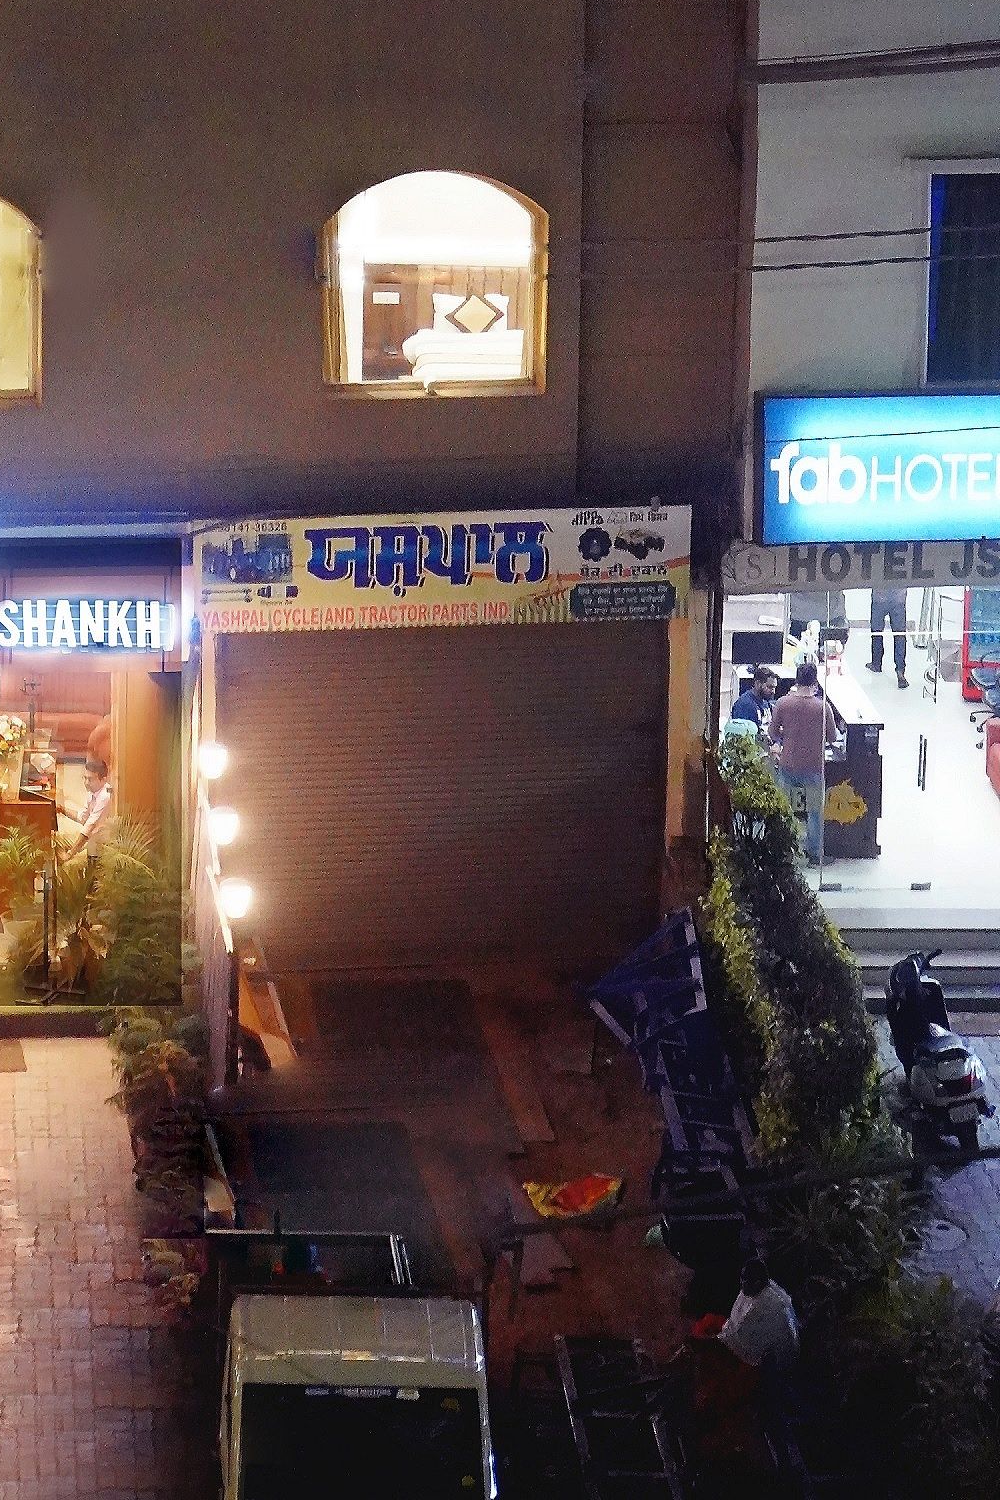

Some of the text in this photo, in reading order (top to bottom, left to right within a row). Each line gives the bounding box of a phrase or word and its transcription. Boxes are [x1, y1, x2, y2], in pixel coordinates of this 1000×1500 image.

[789, 540, 935, 582] HOTEL
[202, 608, 268, 629] YASHPAL
[273, 607, 321, 627] CYCLE
[325, 605, 355, 625] AND
[359, 604, 428, 624] TRACTOR
[431, 603, 479, 622] PARTS
